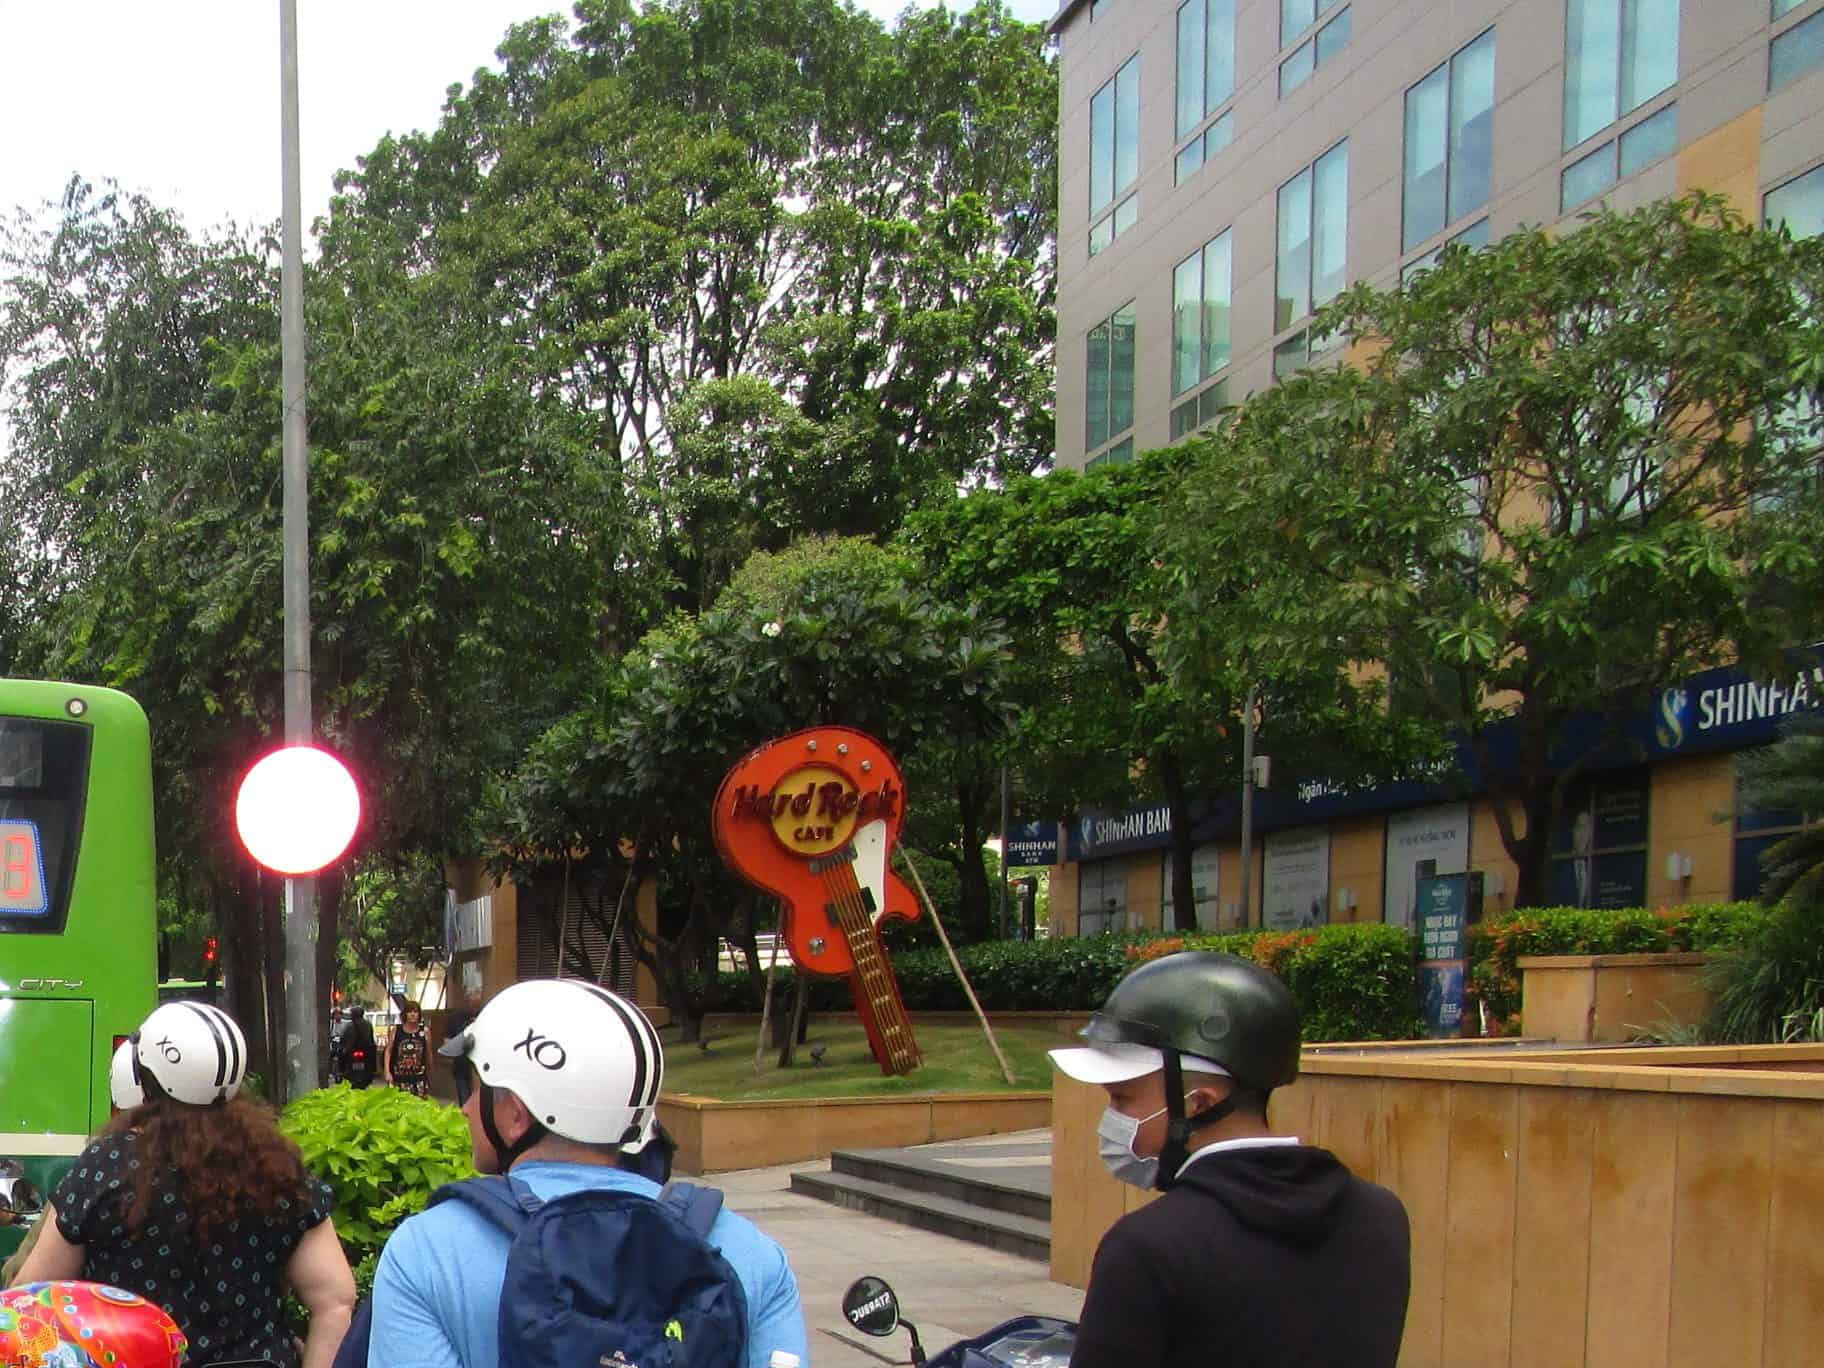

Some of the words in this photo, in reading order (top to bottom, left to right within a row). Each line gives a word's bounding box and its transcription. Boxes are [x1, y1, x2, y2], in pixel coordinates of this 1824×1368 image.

[731, 774, 816, 820] Hard
[817, 777, 899, 824] Rock
[1095, 812, 1143, 845] SHINHAN
[1146, 807, 1171, 834] BAN
[1008, 841, 1056, 851] SHINHAN
[18, 978, 84, 991] CITY
[156, 1035, 181, 1064] XO
[513, 1028, 567, 1070] XO
